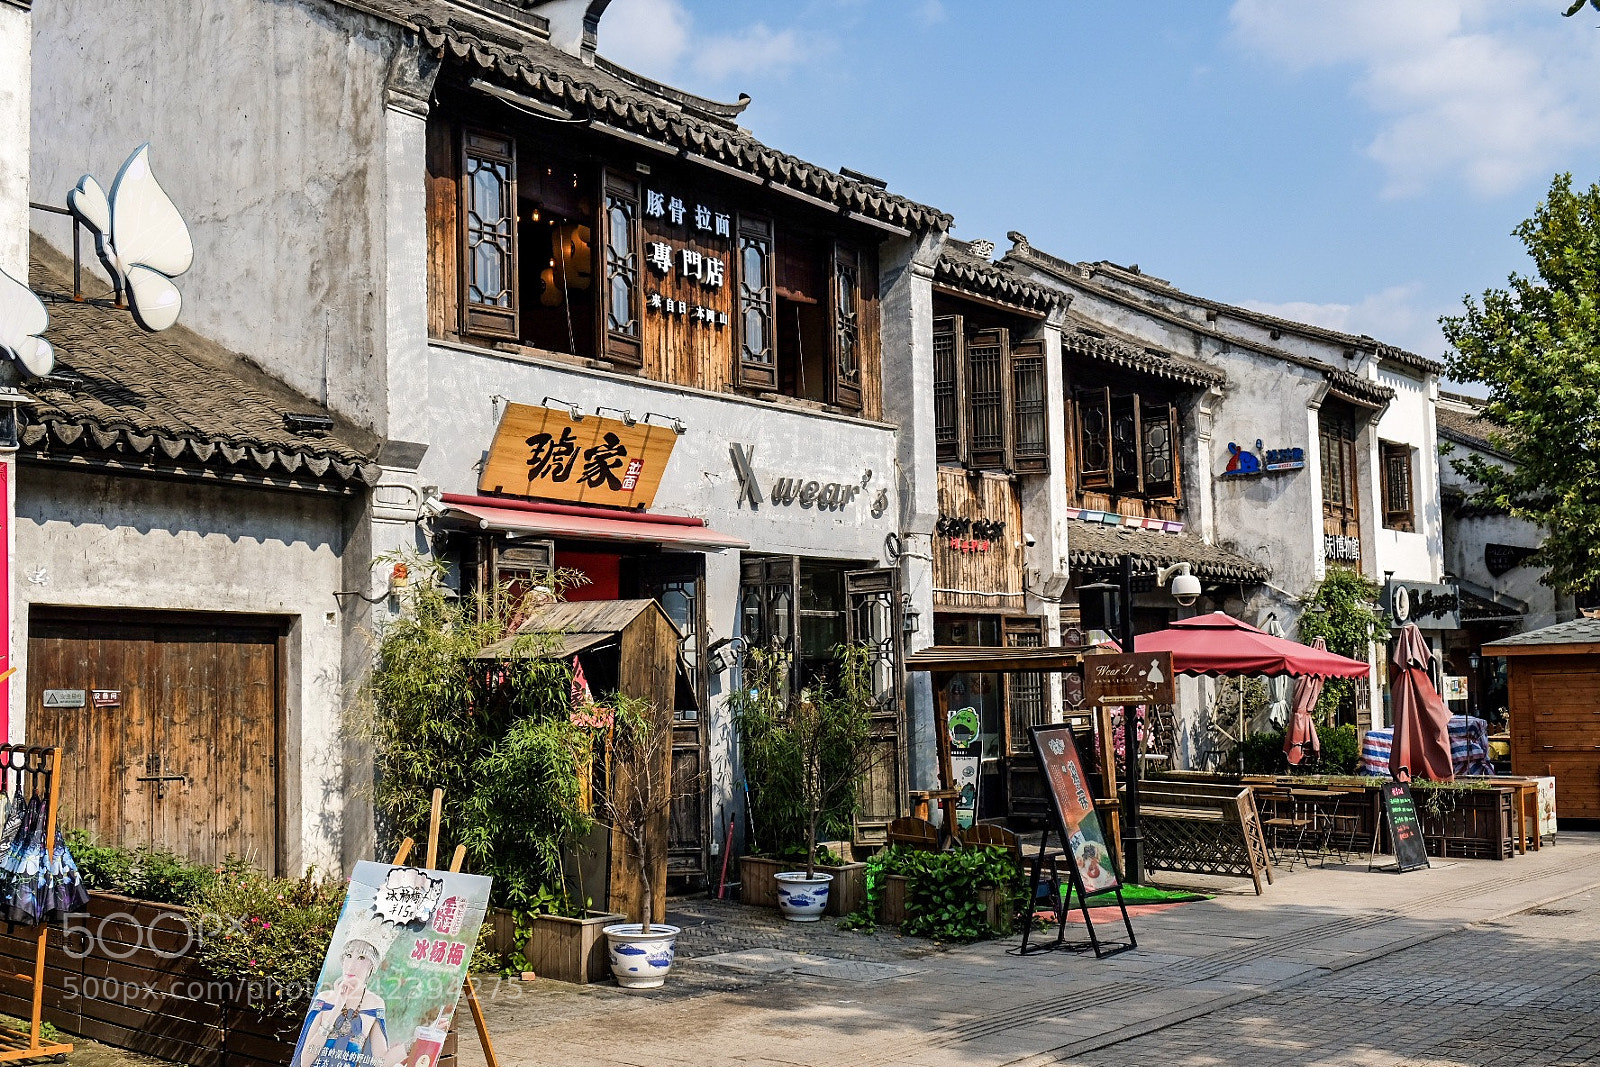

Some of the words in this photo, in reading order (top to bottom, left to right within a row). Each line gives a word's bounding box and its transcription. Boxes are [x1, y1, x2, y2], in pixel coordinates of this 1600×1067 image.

[646, 189, 731, 237] 豚骨拉面
[651, 242, 725, 287] 專門店
[622, 461, 642, 490] 拉面
[1095, 664, 1121, 677] Wear
[411, 939, 466, 966] 冰杨梅
